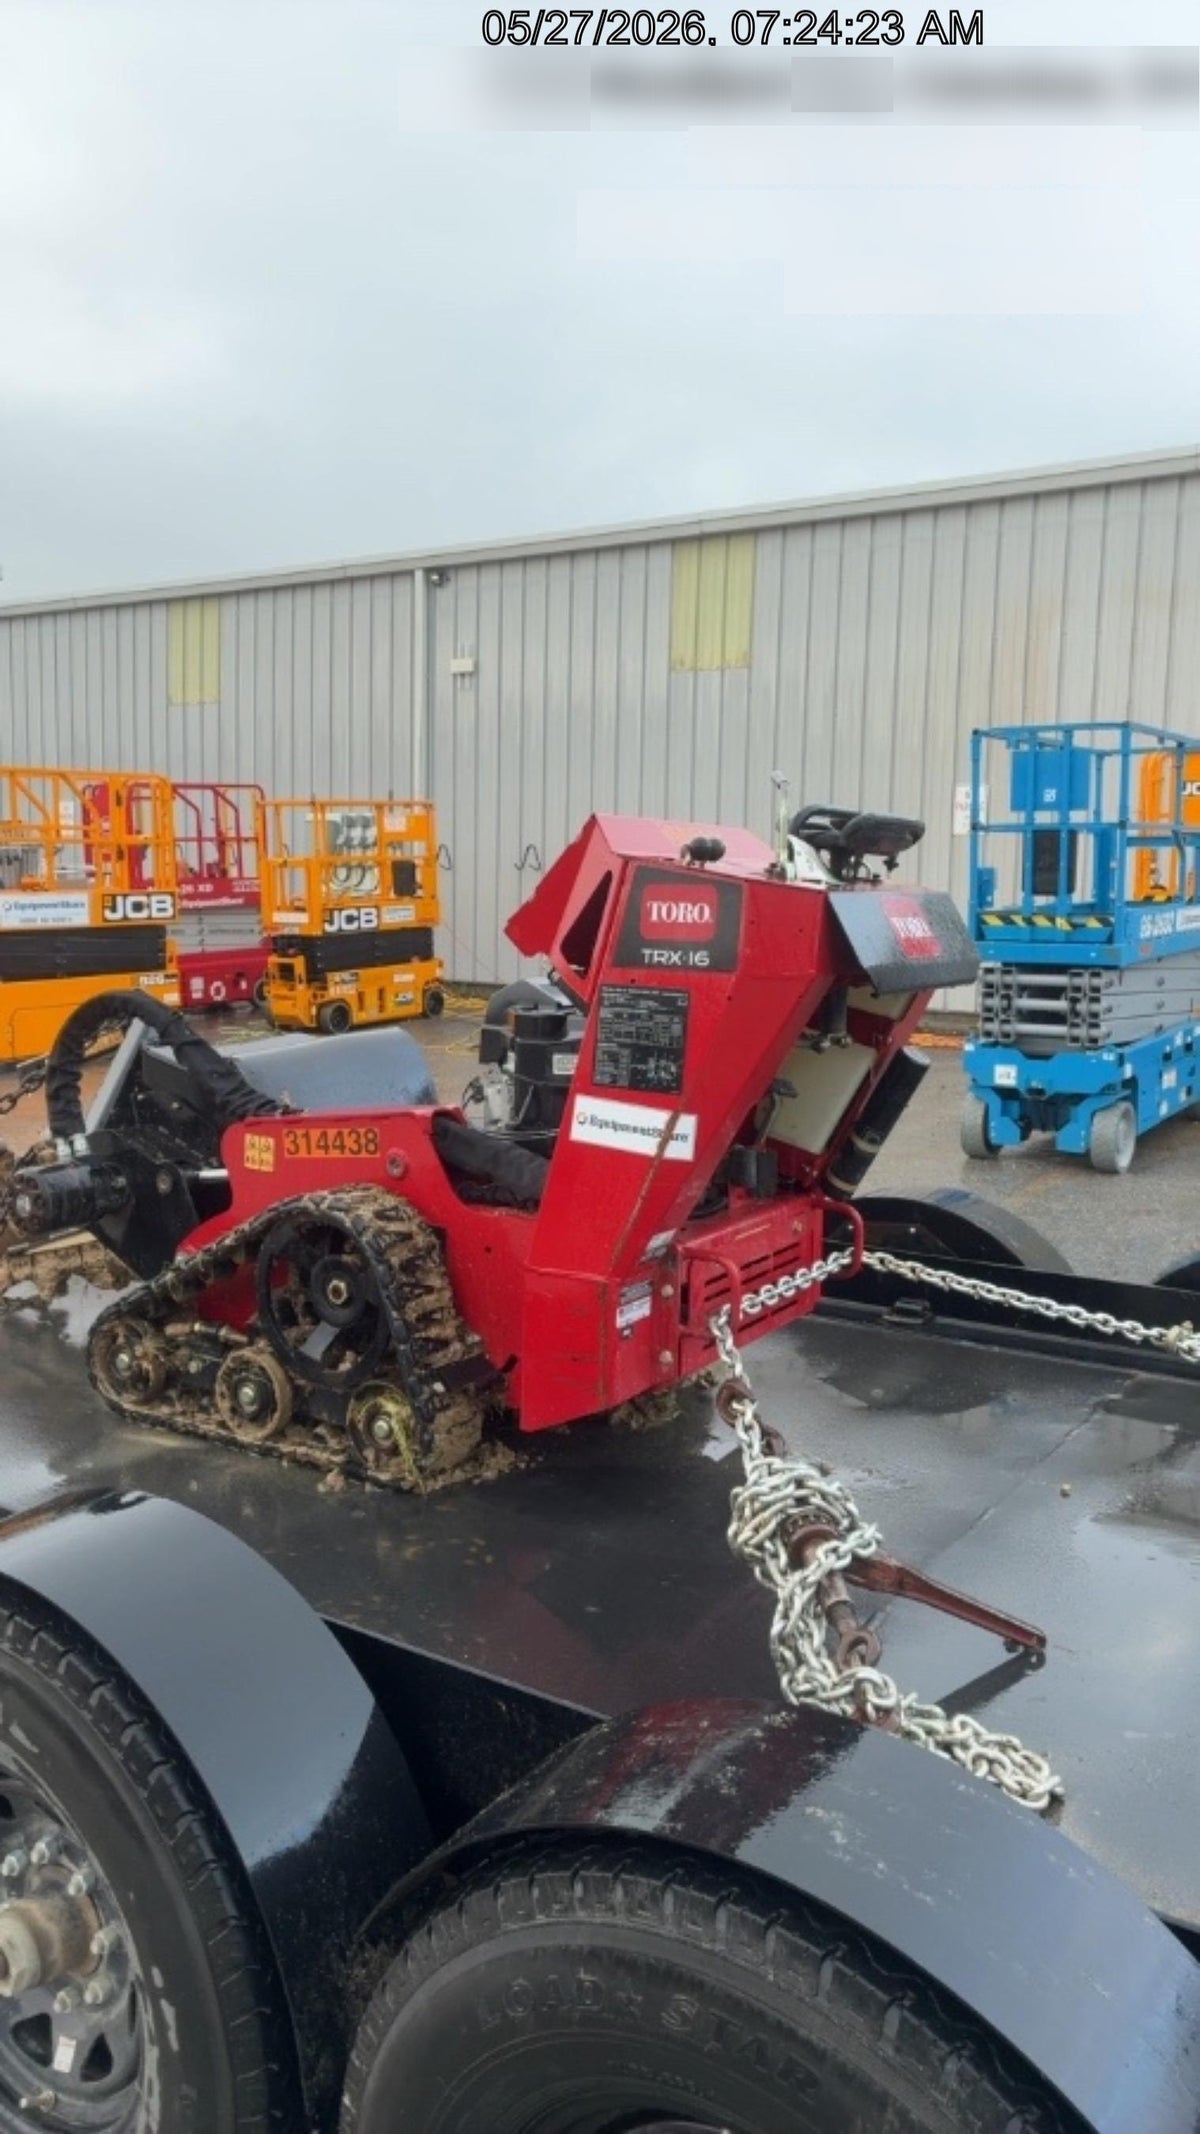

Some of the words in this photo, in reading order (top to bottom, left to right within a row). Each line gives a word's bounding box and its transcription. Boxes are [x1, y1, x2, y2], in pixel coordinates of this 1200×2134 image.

[103, 895, 175, 921] JCB
[324, 908, 379, 932] JCB
[646, 900, 711, 924] TORO
[285, 1129, 379, 1156] 314438
